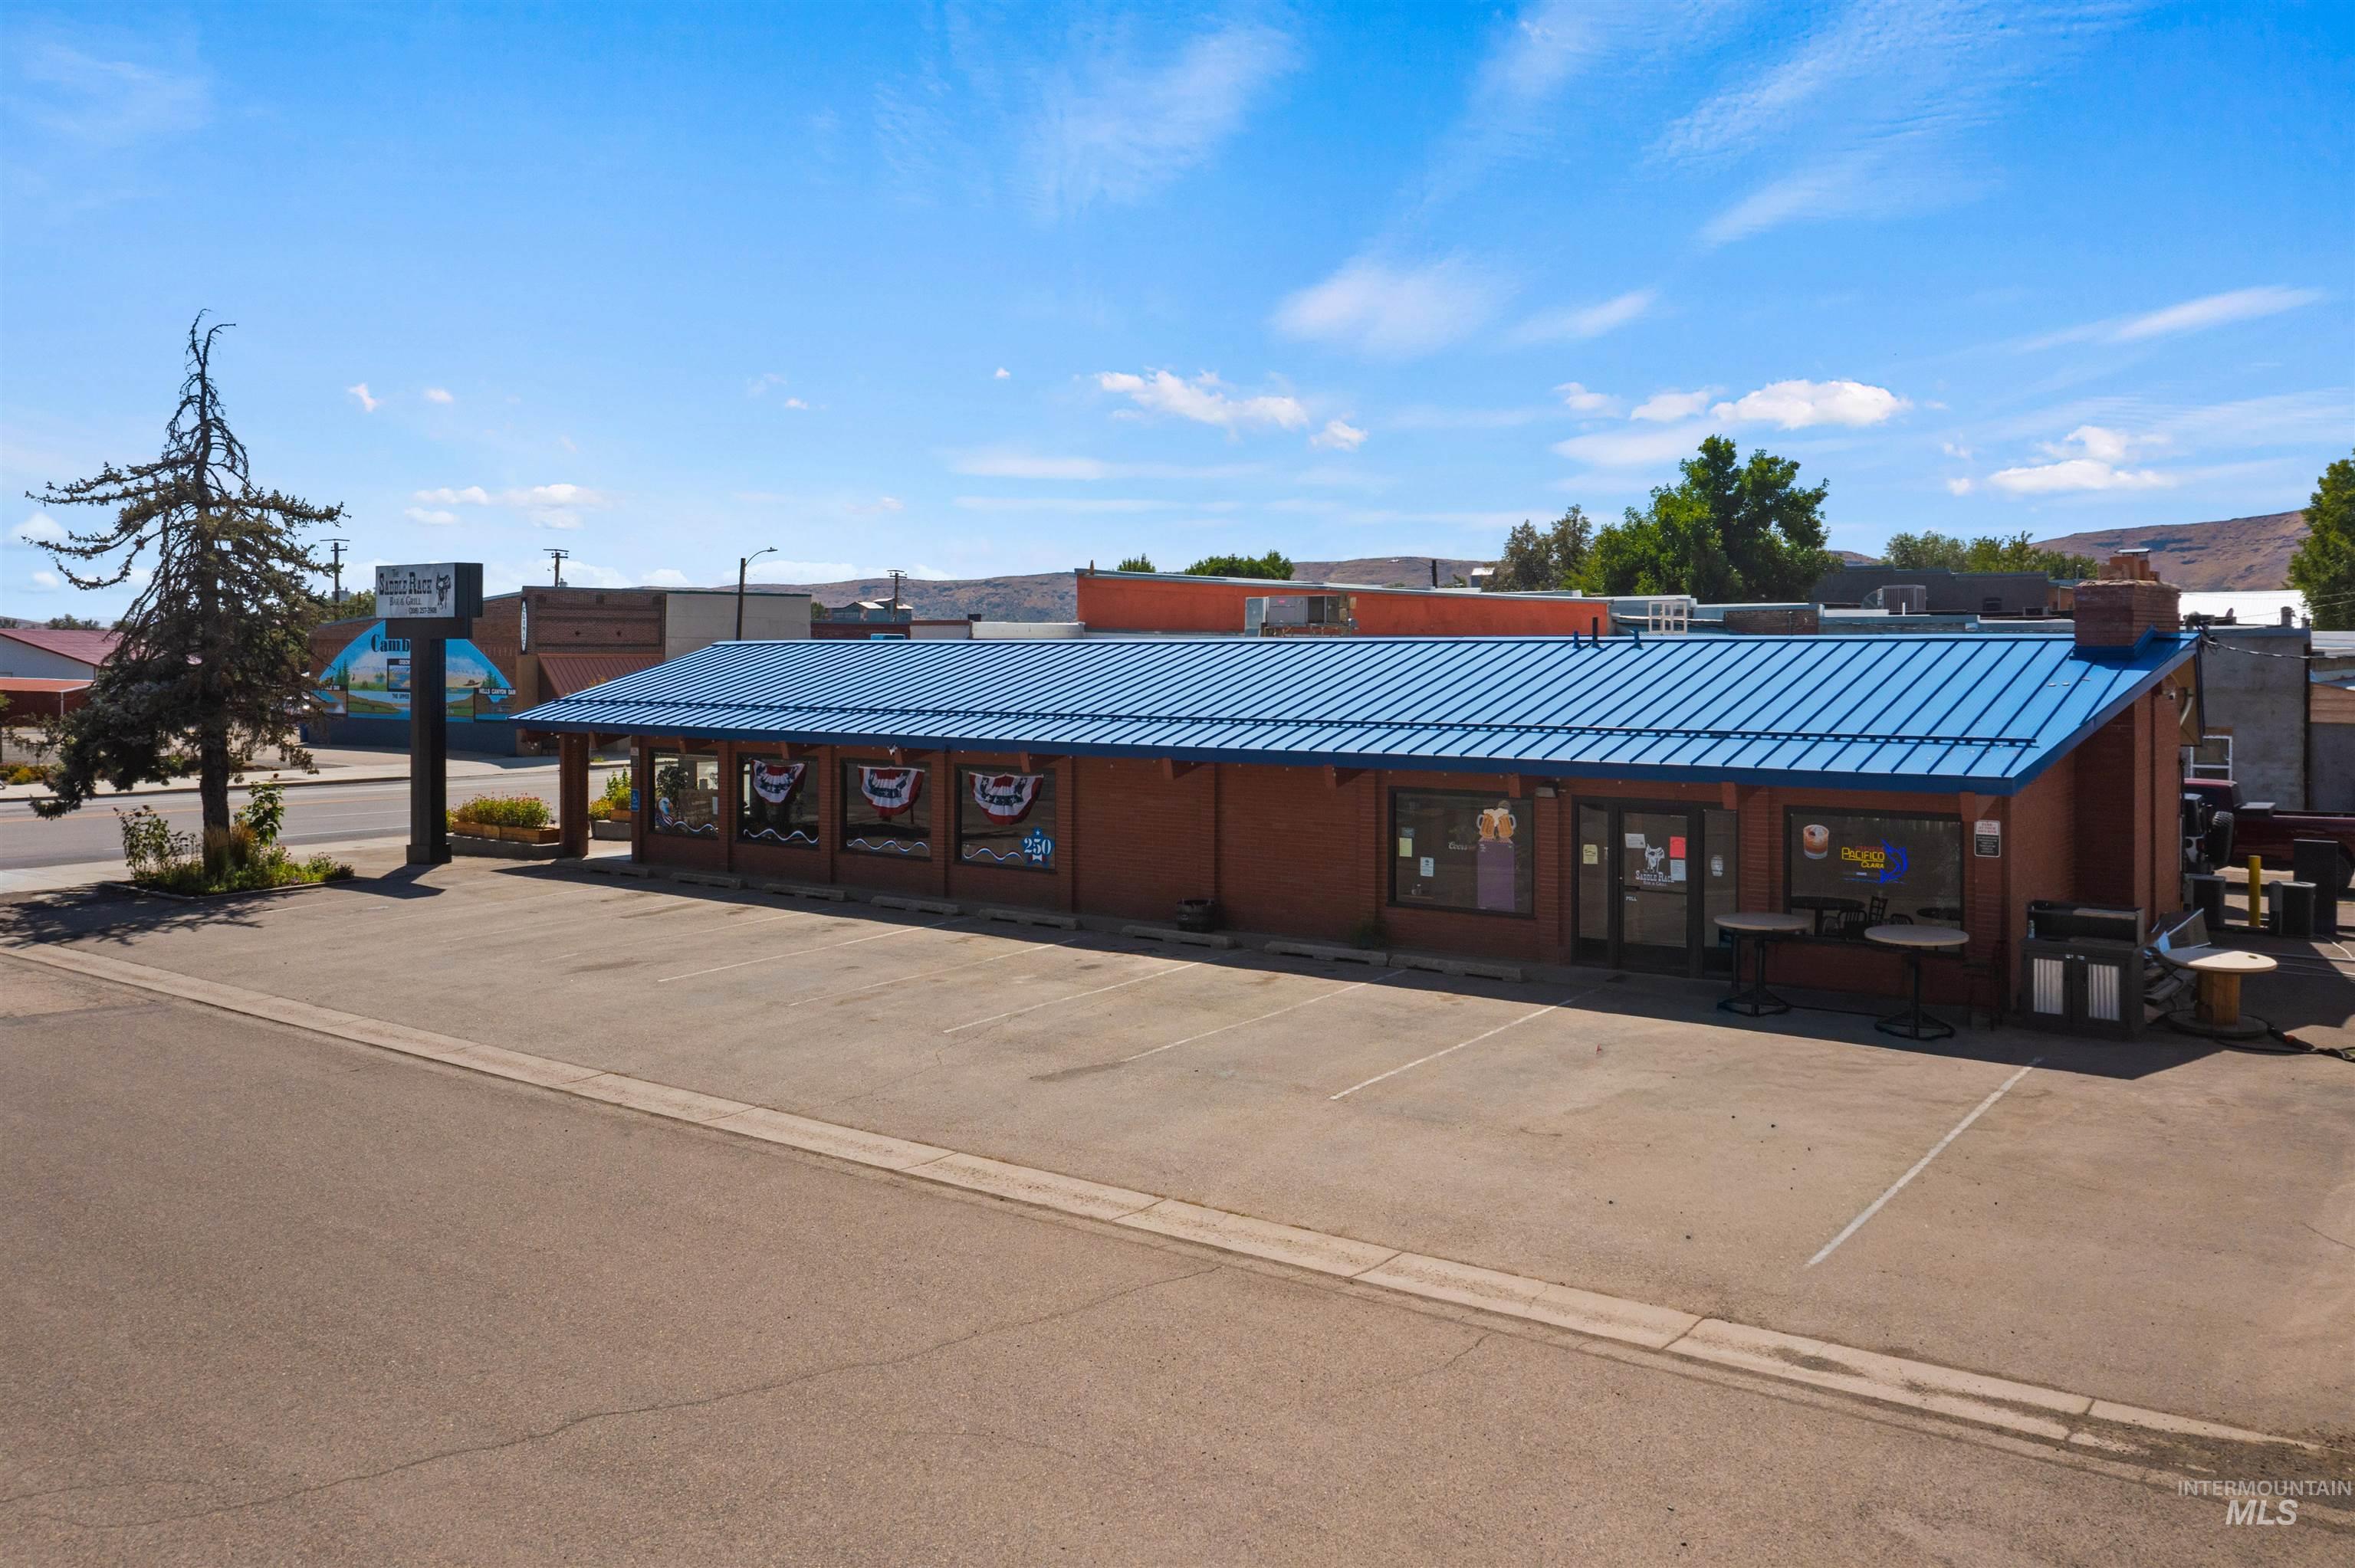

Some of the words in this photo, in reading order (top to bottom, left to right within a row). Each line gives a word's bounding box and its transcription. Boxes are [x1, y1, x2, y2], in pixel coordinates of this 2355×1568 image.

[379, 572, 407, 595] SADDLE
[409, 572, 432, 595] RACK
[389, 596, 399, 606] BAR
[406, 595, 422, 606] GRILL
[371, 634, 411, 653] Camb
[1023, 838, 1052, 855] 250
[1448, 841, 1468, 851] Coors
[1841, 847, 1885, 861] PACIFICO
[1861, 861, 1884, 869] CLARA
[1635, 870, 1657, 881] SADDLE
